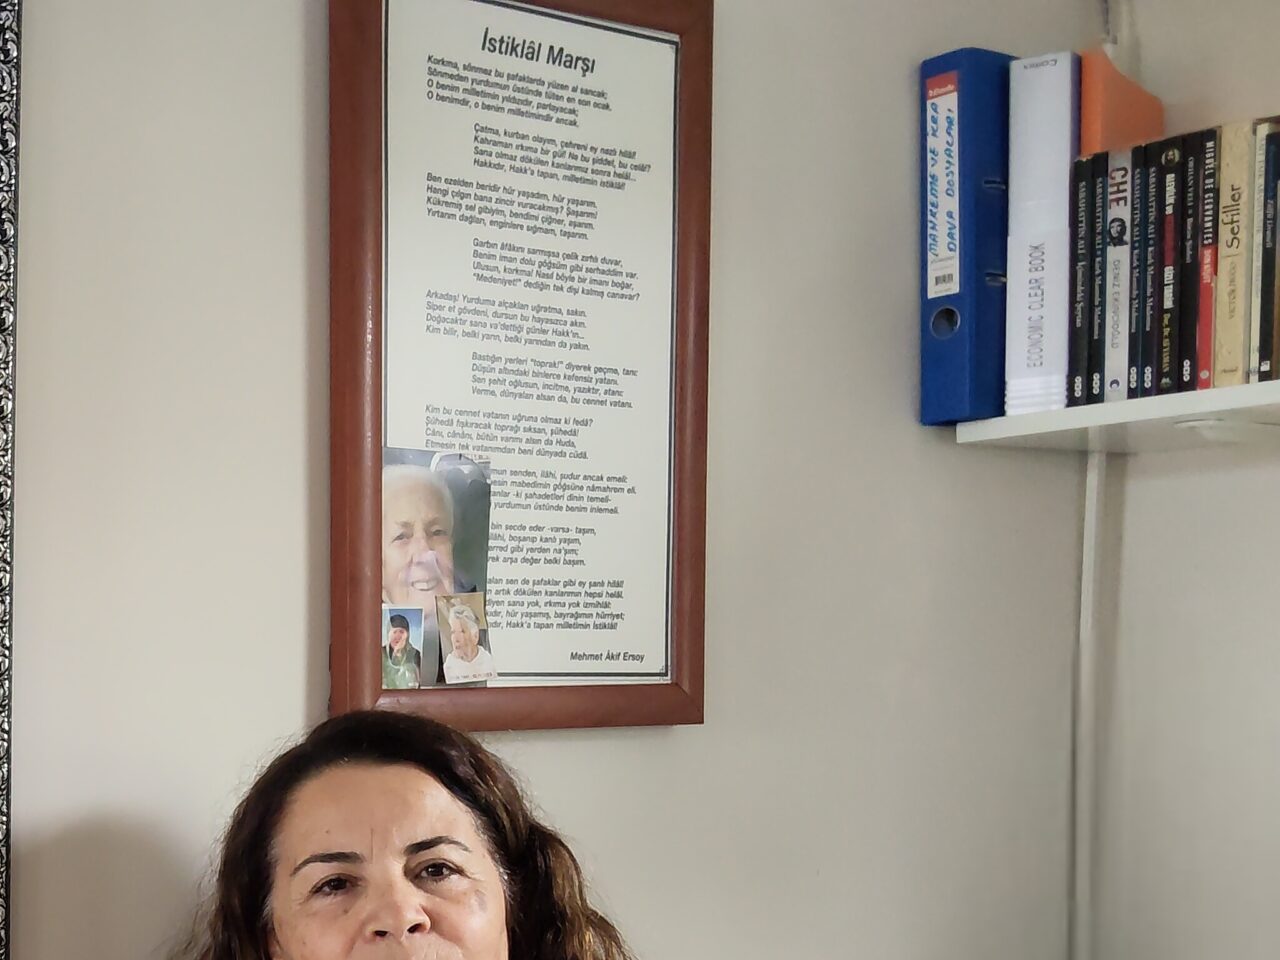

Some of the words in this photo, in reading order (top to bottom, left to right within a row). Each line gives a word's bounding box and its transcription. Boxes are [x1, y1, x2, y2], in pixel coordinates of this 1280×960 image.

[481, 26, 542, 62] İstiklâl
[546, 44, 595, 77] Marşı
[929, 146, 938, 167] VE
[1206, 141, 1214, 174] MIGUEL
[1108, 166, 1129, 210] CHE
[1205, 178, 1214, 190] DE
[946, 210, 956, 252] DAVA
[1204, 194, 1214, 244] CERVANTES
[1222, 184, 1241, 249] Sefiller
[1028, 242, 1045, 273] BOOK
[1028, 276, 1044, 311] CLEAR
[1026, 315, 1044, 368] ECONOMIC
[569, 651, 603, 661] Mehmet
[604, 650, 621, 661] Âkif
[622, 651, 645, 663] Ersoy
